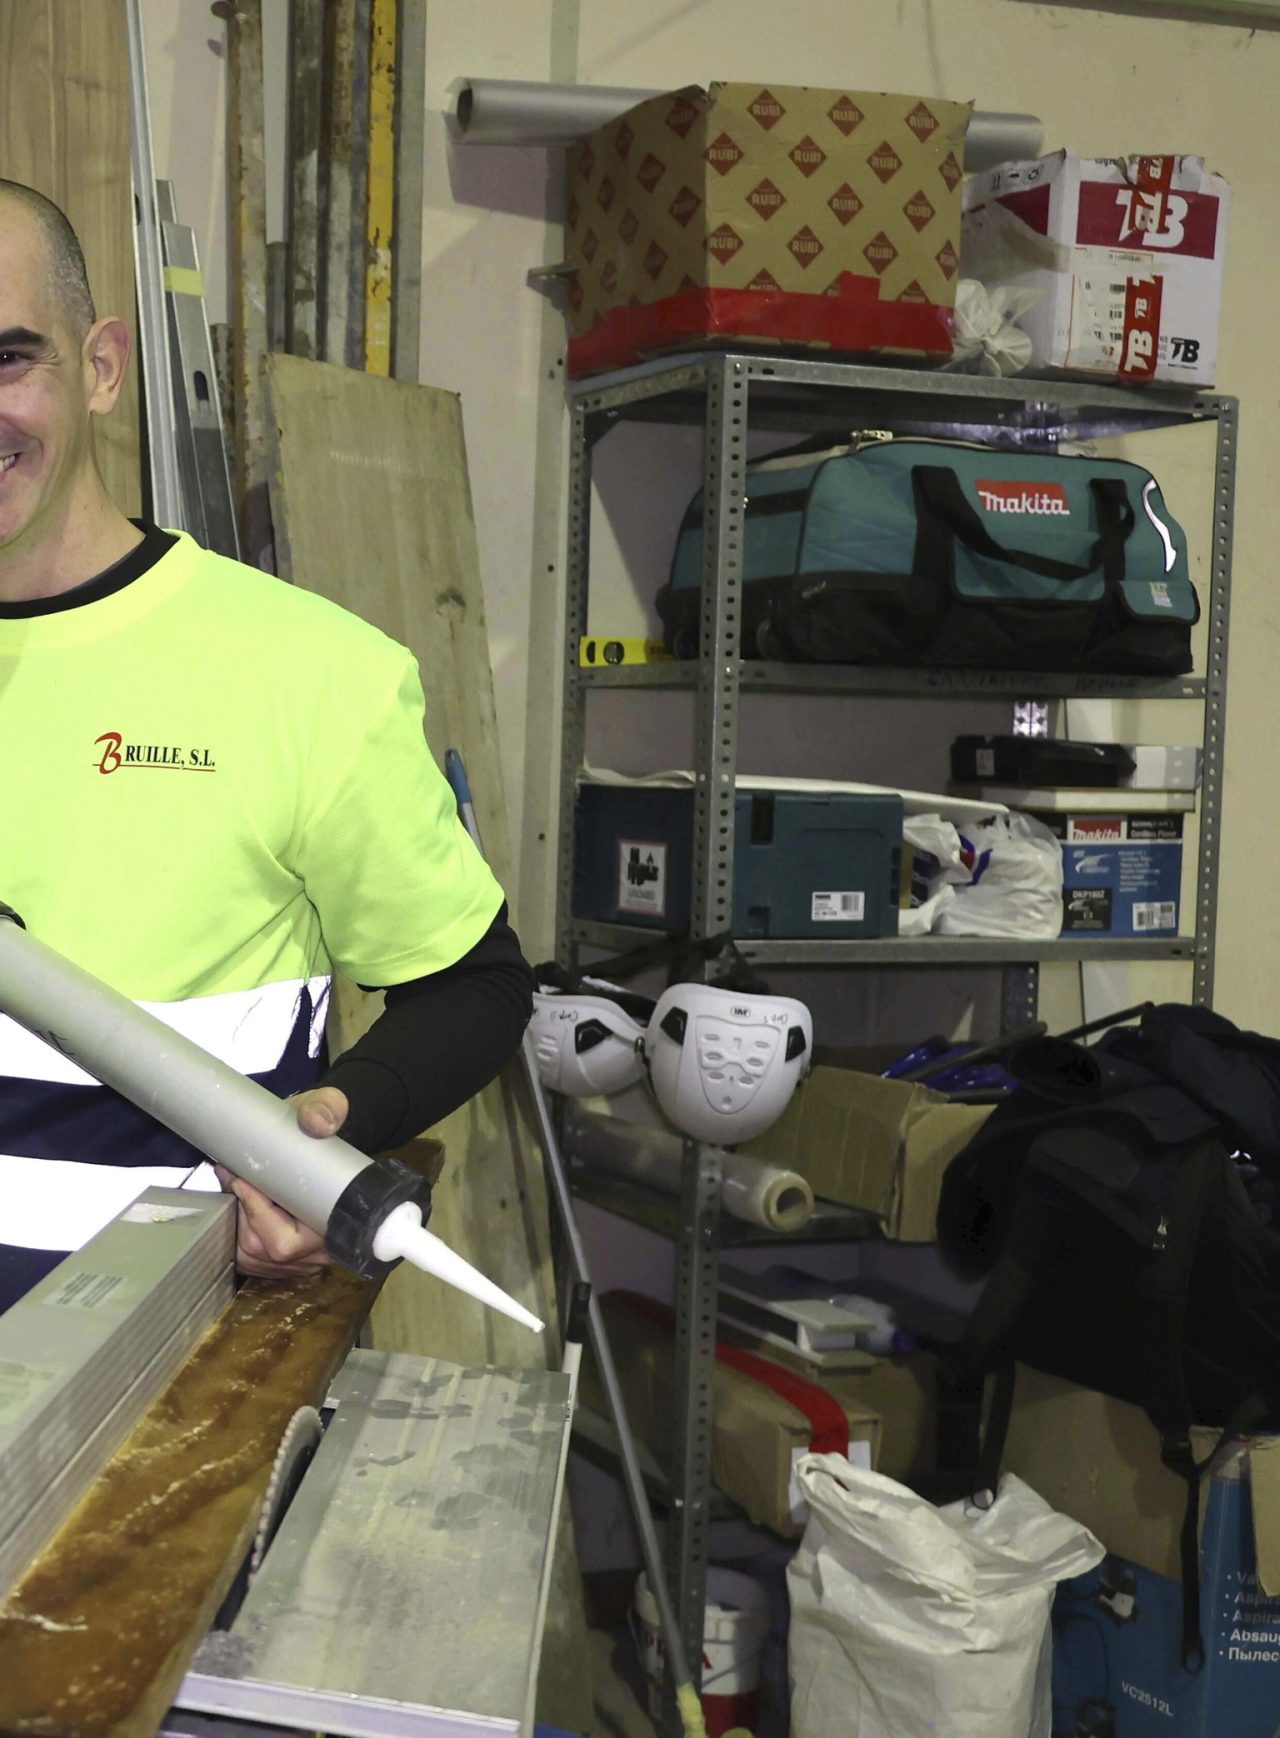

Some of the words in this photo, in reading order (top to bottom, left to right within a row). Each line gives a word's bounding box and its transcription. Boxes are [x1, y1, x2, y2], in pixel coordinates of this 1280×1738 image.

[752, 105, 781, 117] RUBI
[832, 109, 859, 122] RUBI
[910, 116, 934, 129] RUBI
[709, 148, 738, 161] RUBI
[794, 149, 821, 163] RUBI
[871, 156, 898, 169] RUBI
[751, 194, 781, 206] RUBI
[832, 199, 859, 212] RUBI
[907, 205, 931, 218] RUBI
[709, 236, 738, 249] RUBI
[791, 241, 819, 253] RUBI
[867, 246, 893, 259] RUBI
[189, 748, 216, 767] S.L.
[1122, 1680, 1174, 1717] VC2512L
